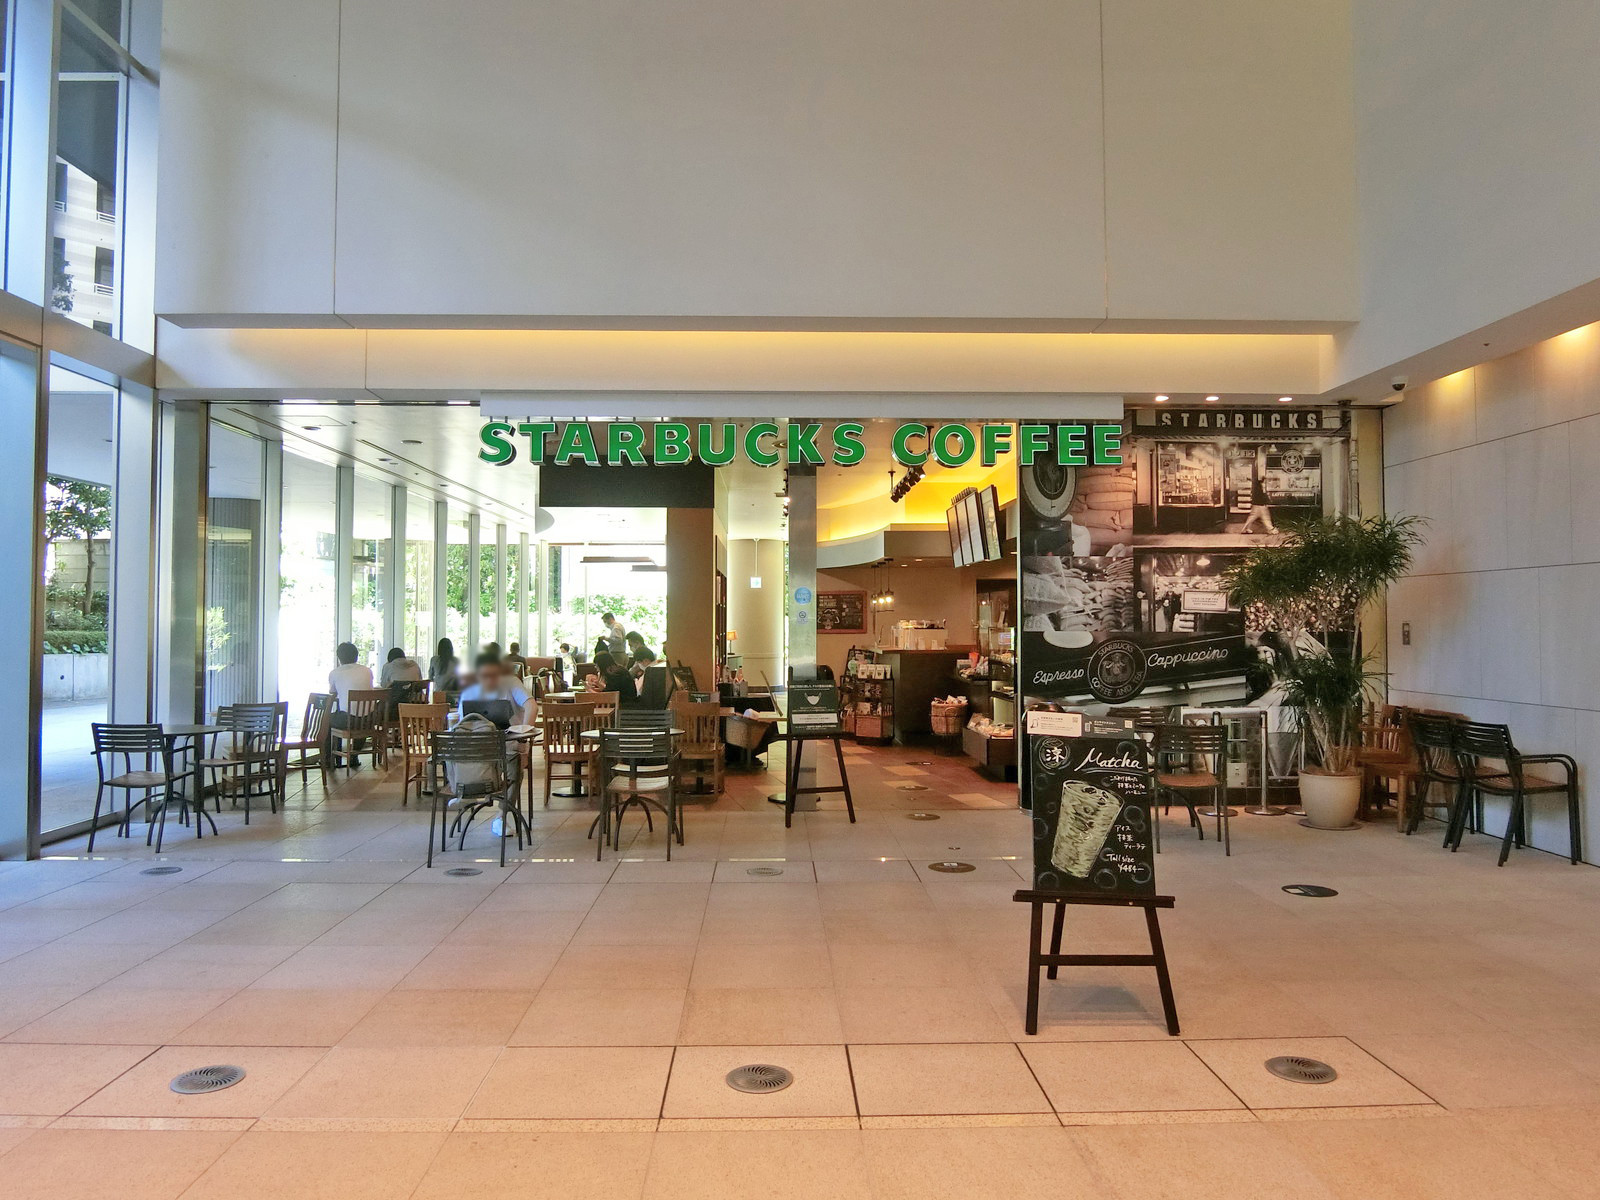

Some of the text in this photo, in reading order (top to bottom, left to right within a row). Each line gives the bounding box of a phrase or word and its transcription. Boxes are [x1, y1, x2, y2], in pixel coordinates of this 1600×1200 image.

[1161, 412, 1318, 429] STARBUCKS
[478, 421, 1124, 467] STARBUCKS COFFEE
[1098, 642, 1134, 657] STARBUCKS
[1147, 646, 1229, 668] Cappuccino
[1033, 668, 1085, 685] Espresso
[1073, 747, 1144, 772] Matcha
[1114, 824, 1132, 832] アイス
[1106, 853, 1121, 862] Tall
